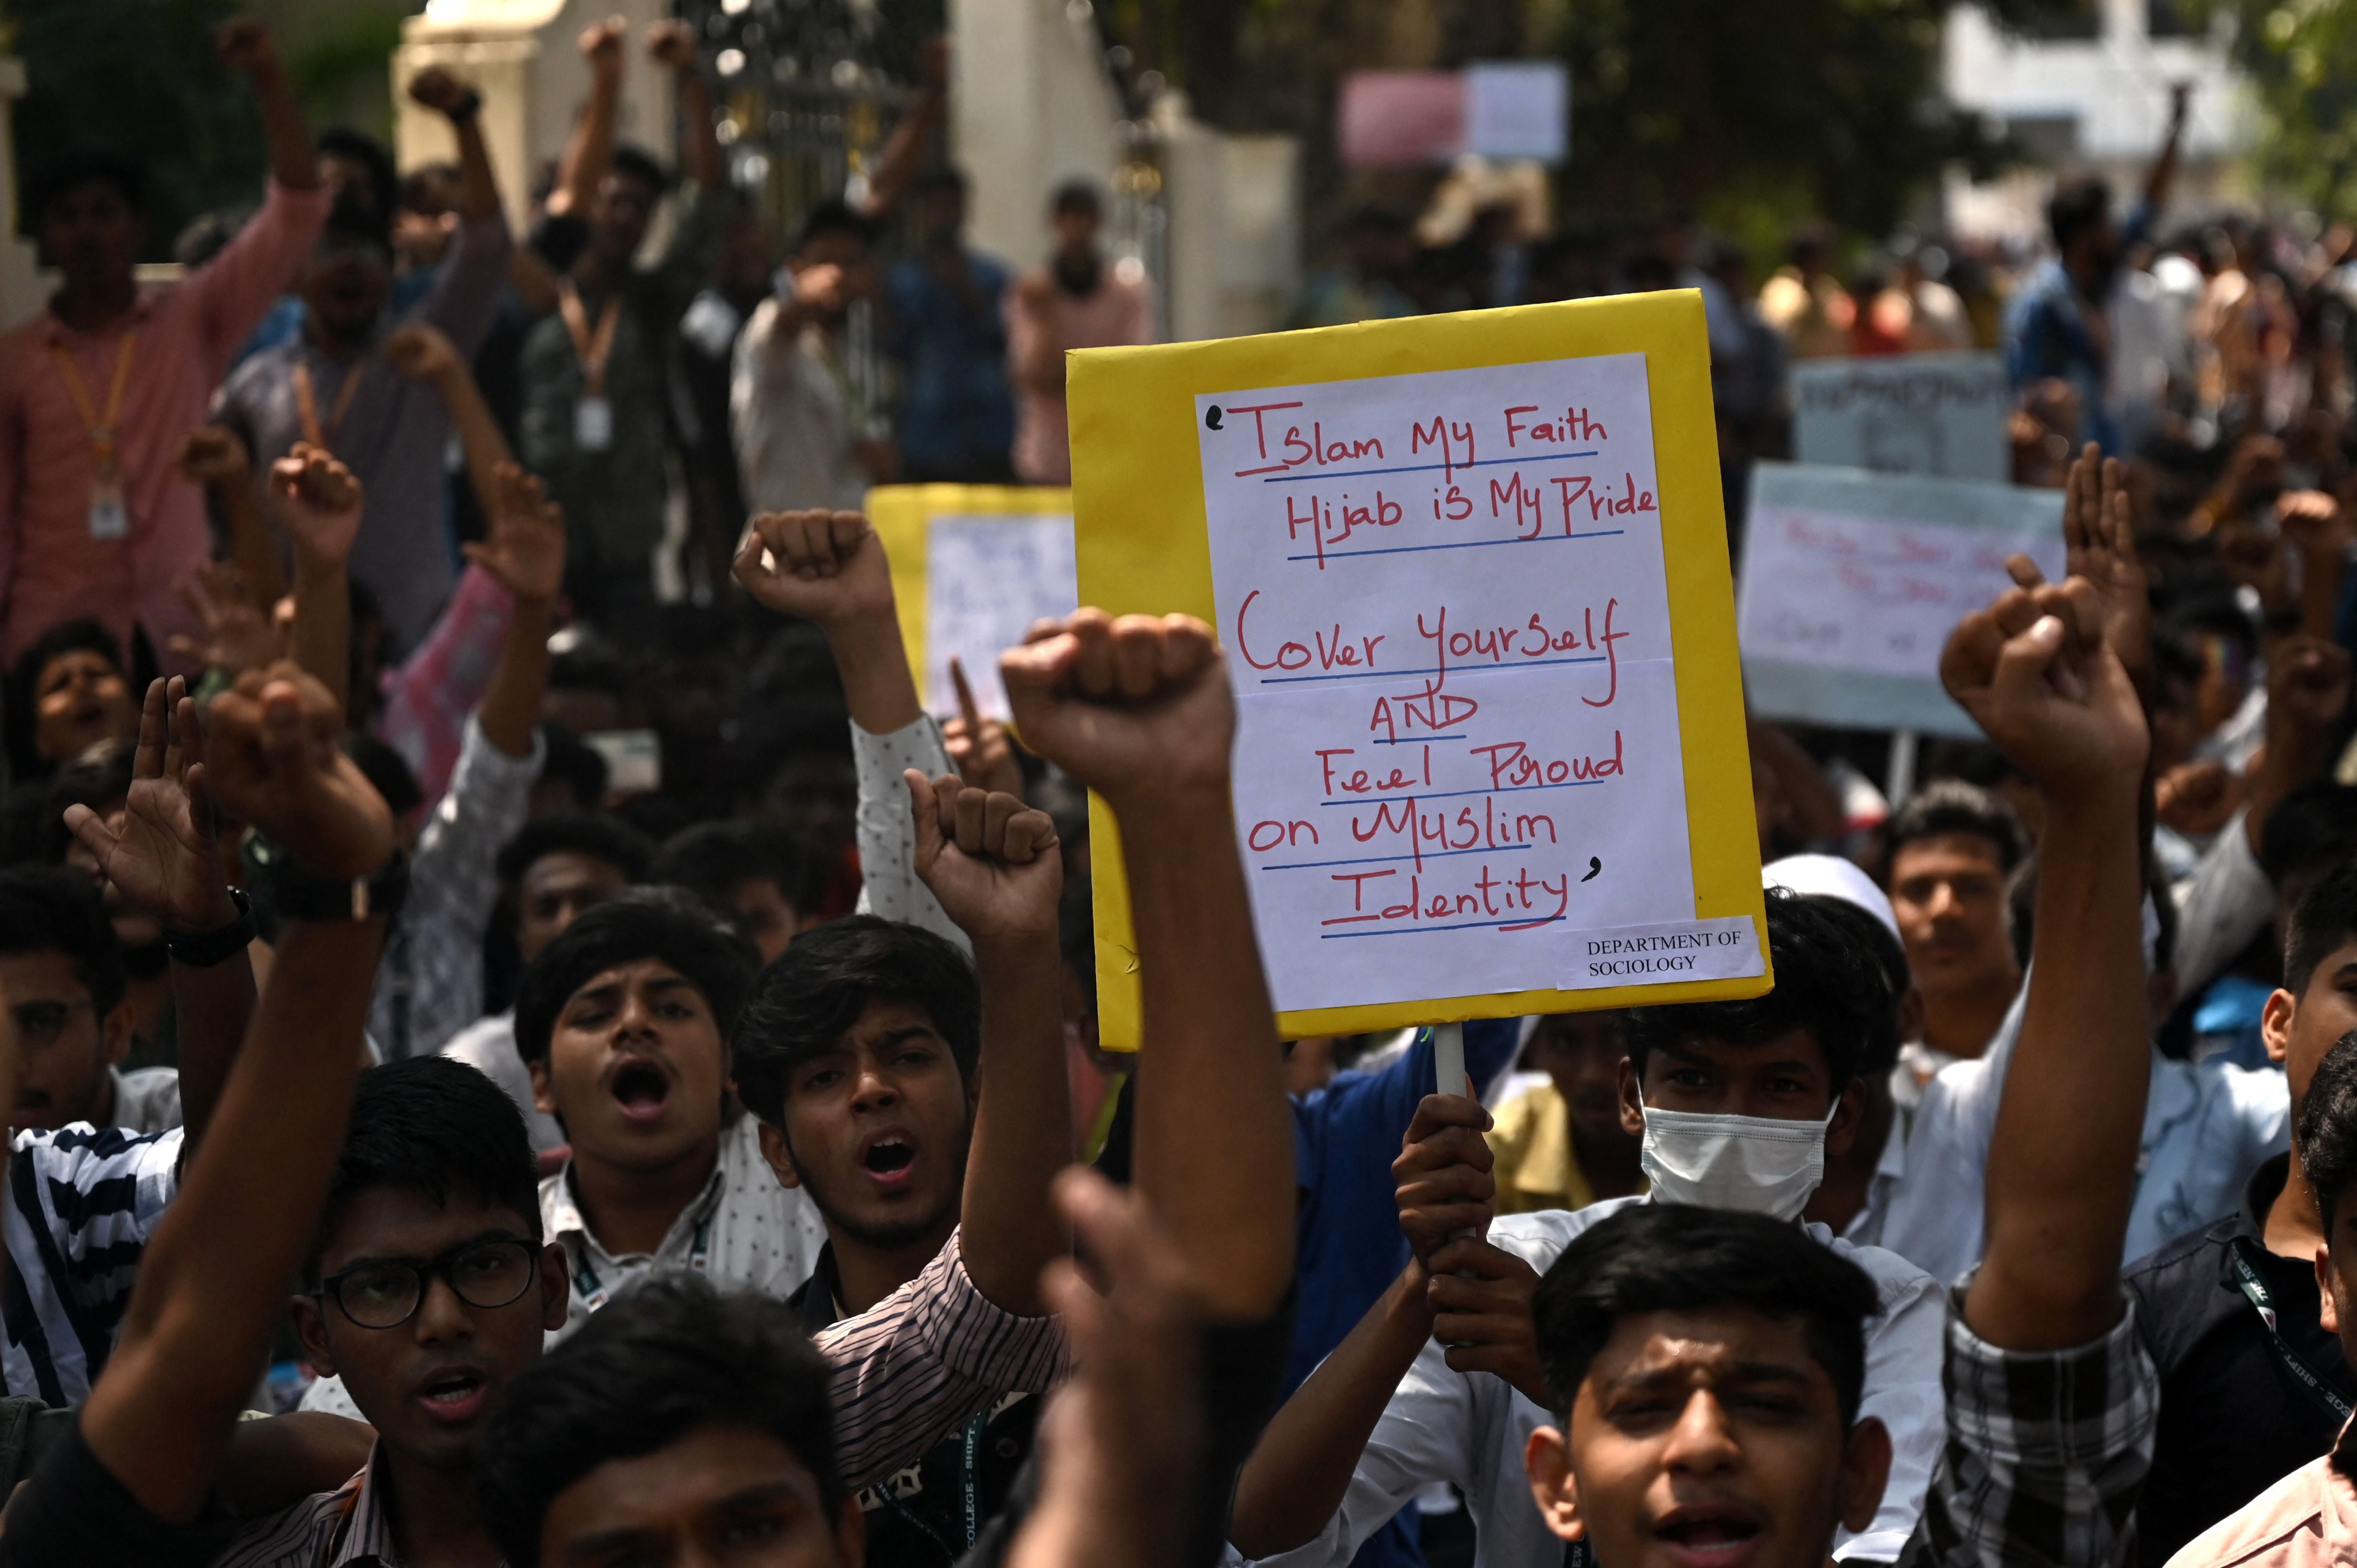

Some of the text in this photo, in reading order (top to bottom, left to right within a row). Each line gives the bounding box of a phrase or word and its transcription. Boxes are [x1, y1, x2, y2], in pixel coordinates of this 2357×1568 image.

[1413, 416, 1474, 484] My
[1505, 406, 1608, 447] Faith
[1287, 472, 1657, 569] Hijab is My Pride
[1238, 590, 1385, 670] Cover
[1371, 679, 1478, 743] AND
[1316, 730, 1624, 796] Feel Proud
[1352, 797, 1557, 874] Muslim
[1588, 931, 1741, 955] DEPARTMENT OF
[1589, 955, 1697, 977] SOCIOLOGY
[2285, 1354, 2318, 1388] SHIFT
[965, 1428, 976, 1470] SHIFT
[966, 1483, 976, 1550] COLLEGE
